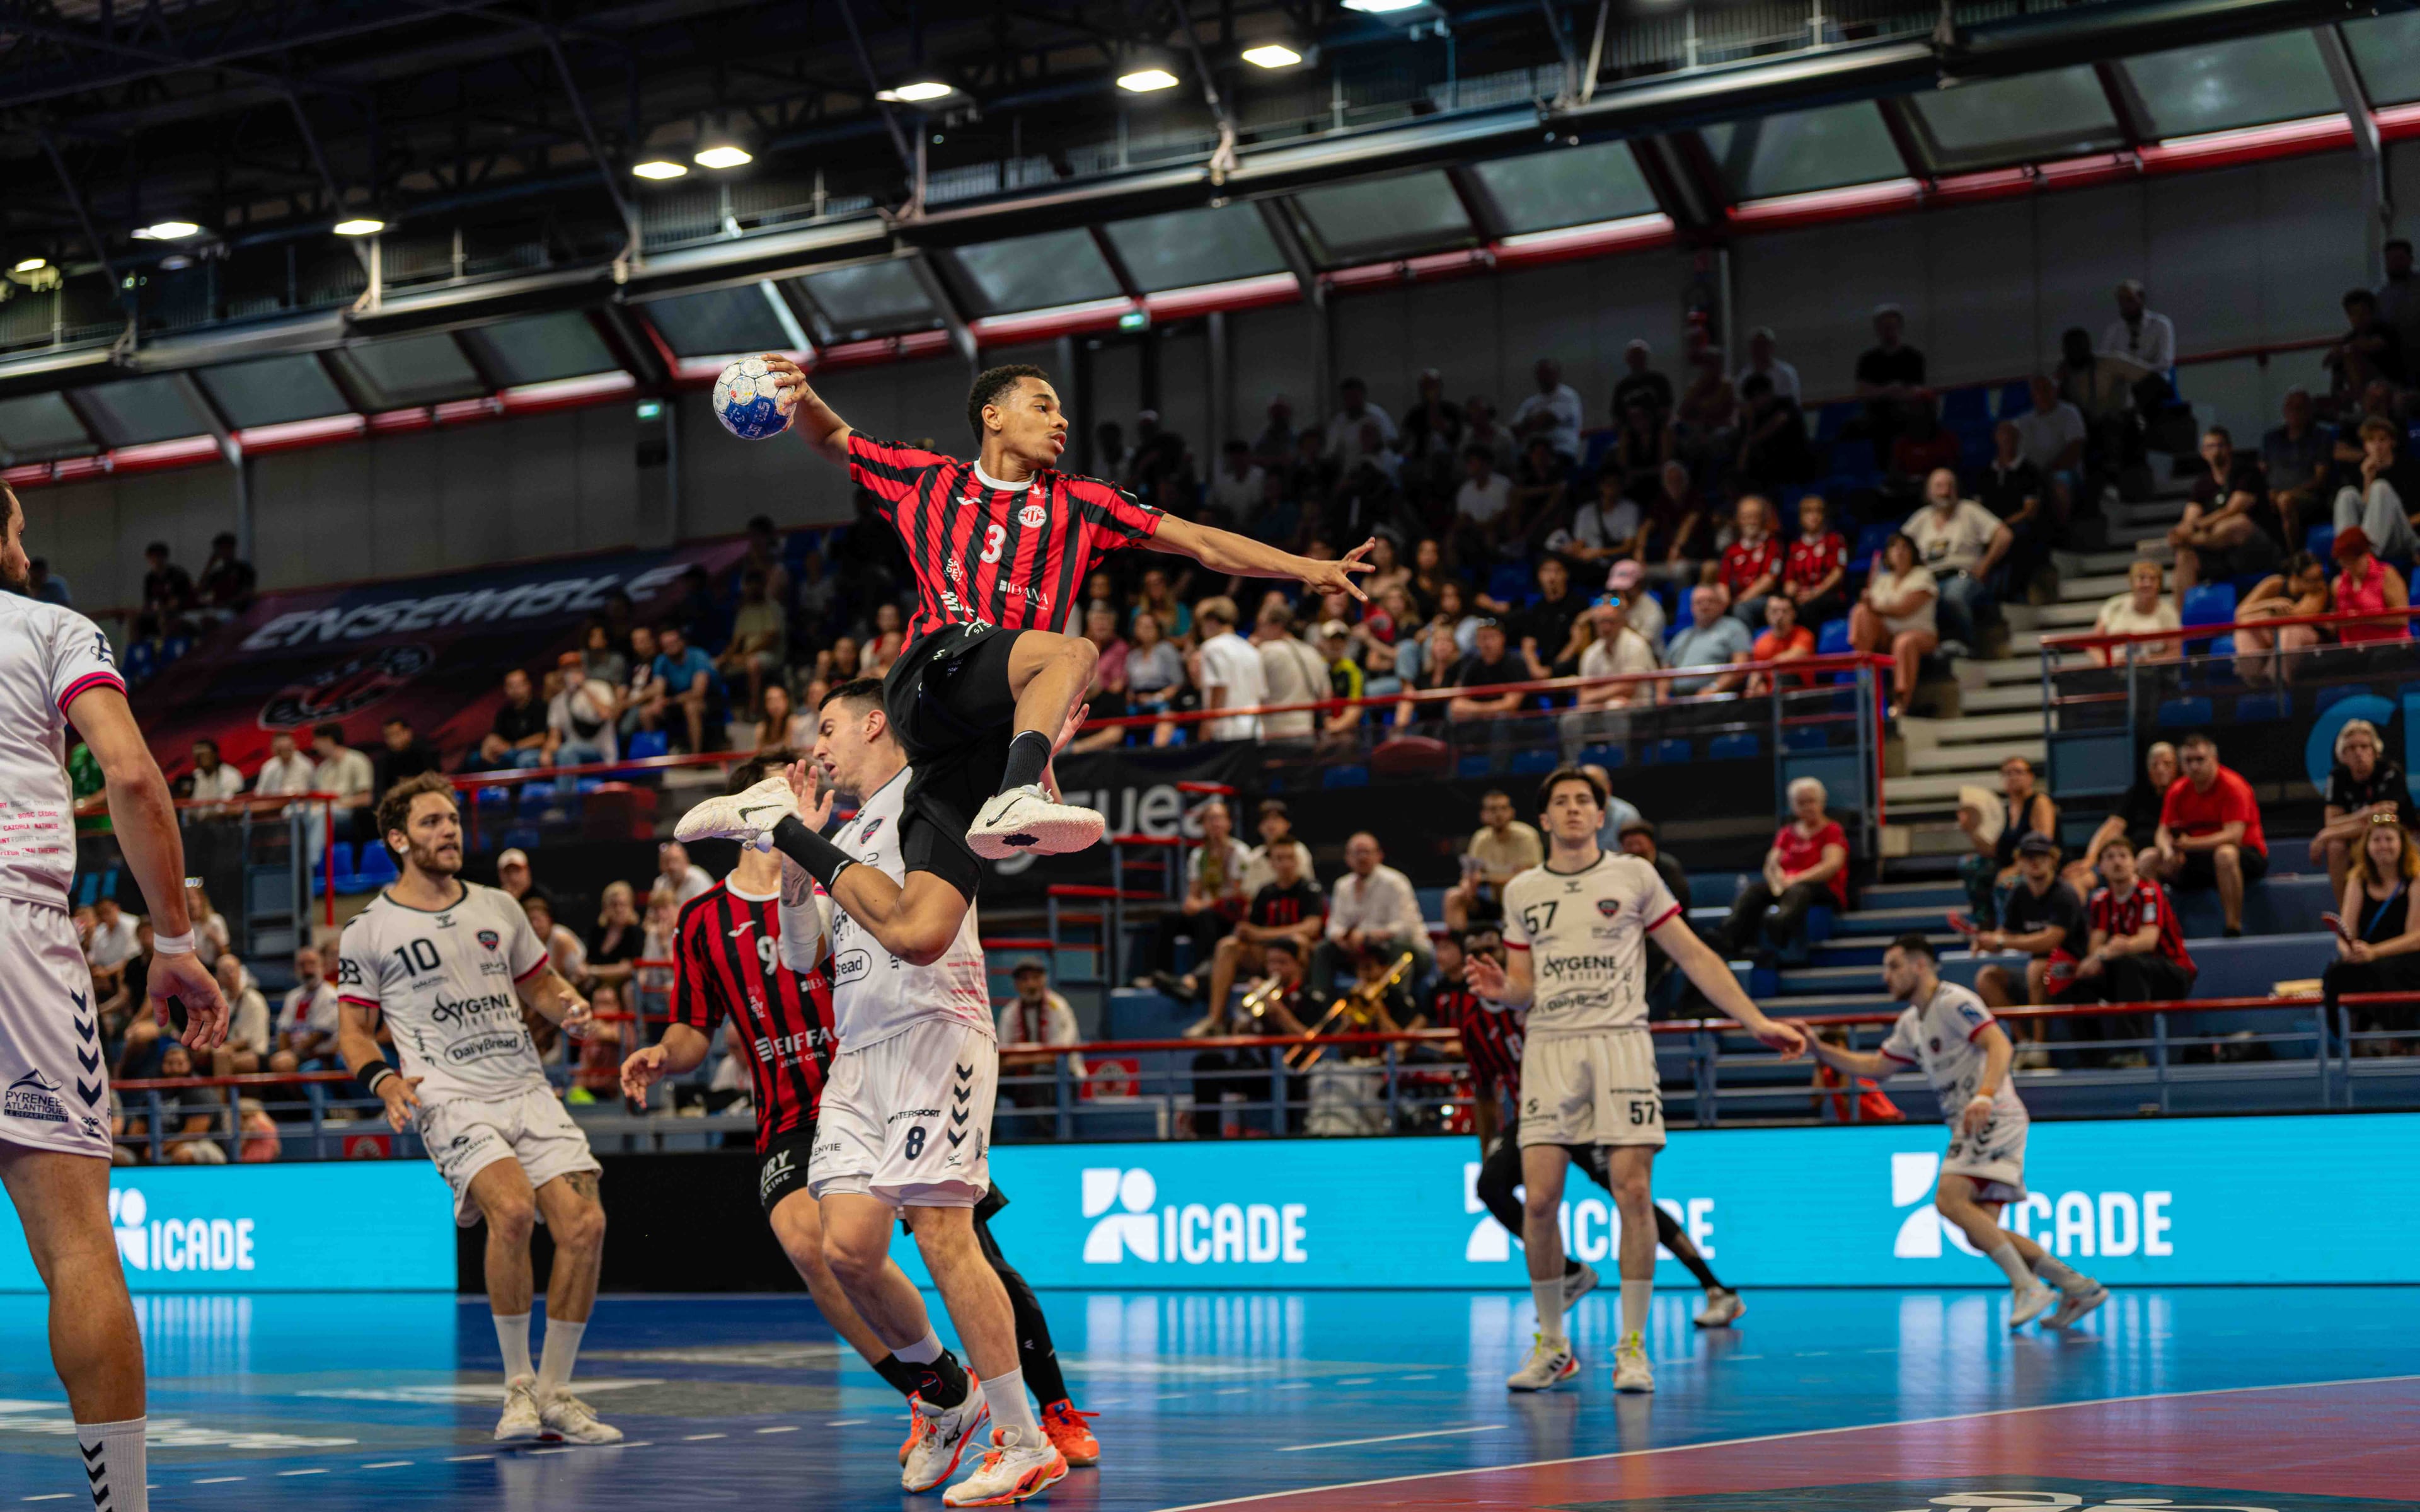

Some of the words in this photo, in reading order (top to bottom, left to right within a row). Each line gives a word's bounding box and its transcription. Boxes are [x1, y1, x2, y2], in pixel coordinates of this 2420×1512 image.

[980, 524, 1006, 564] 3
[238, 562, 694, 651] ENSEMBLE
[1007, 582, 1049, 605] IBANA
[1524, 901, 1559, 936] 57
[393, 938, 441, 977] 10
[452, 1037, 517, 1060] DailyBread
[4, 1101, 69, 1115] ATLANTIQUES
[1630, 1101, 1655, 1125] 57
[905, 1126, 926, 1161] 8
[151, 1218, 255, 1271] ICADE
[1163, 1203, 1308, 1265] ICADE
